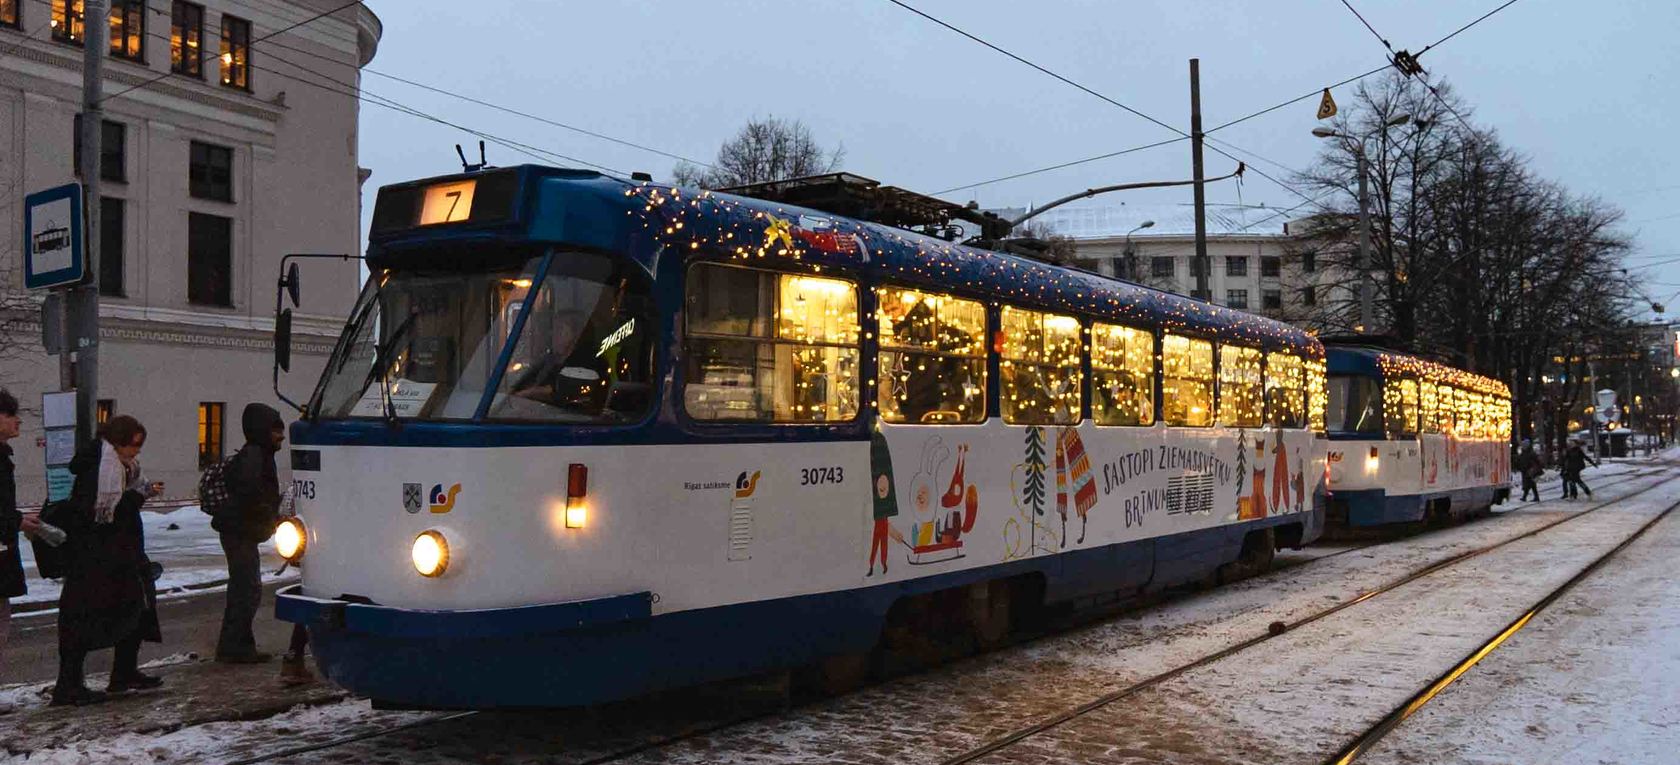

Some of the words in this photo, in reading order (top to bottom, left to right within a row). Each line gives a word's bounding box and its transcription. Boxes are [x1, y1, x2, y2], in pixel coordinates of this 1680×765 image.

[445, 190, 462, 223] 7
[801, 466, 844, 486] 30743
[1103, 448, 1154, 495] SASTOPI
[1124, 488, 1181, 528] BRĪNUM
